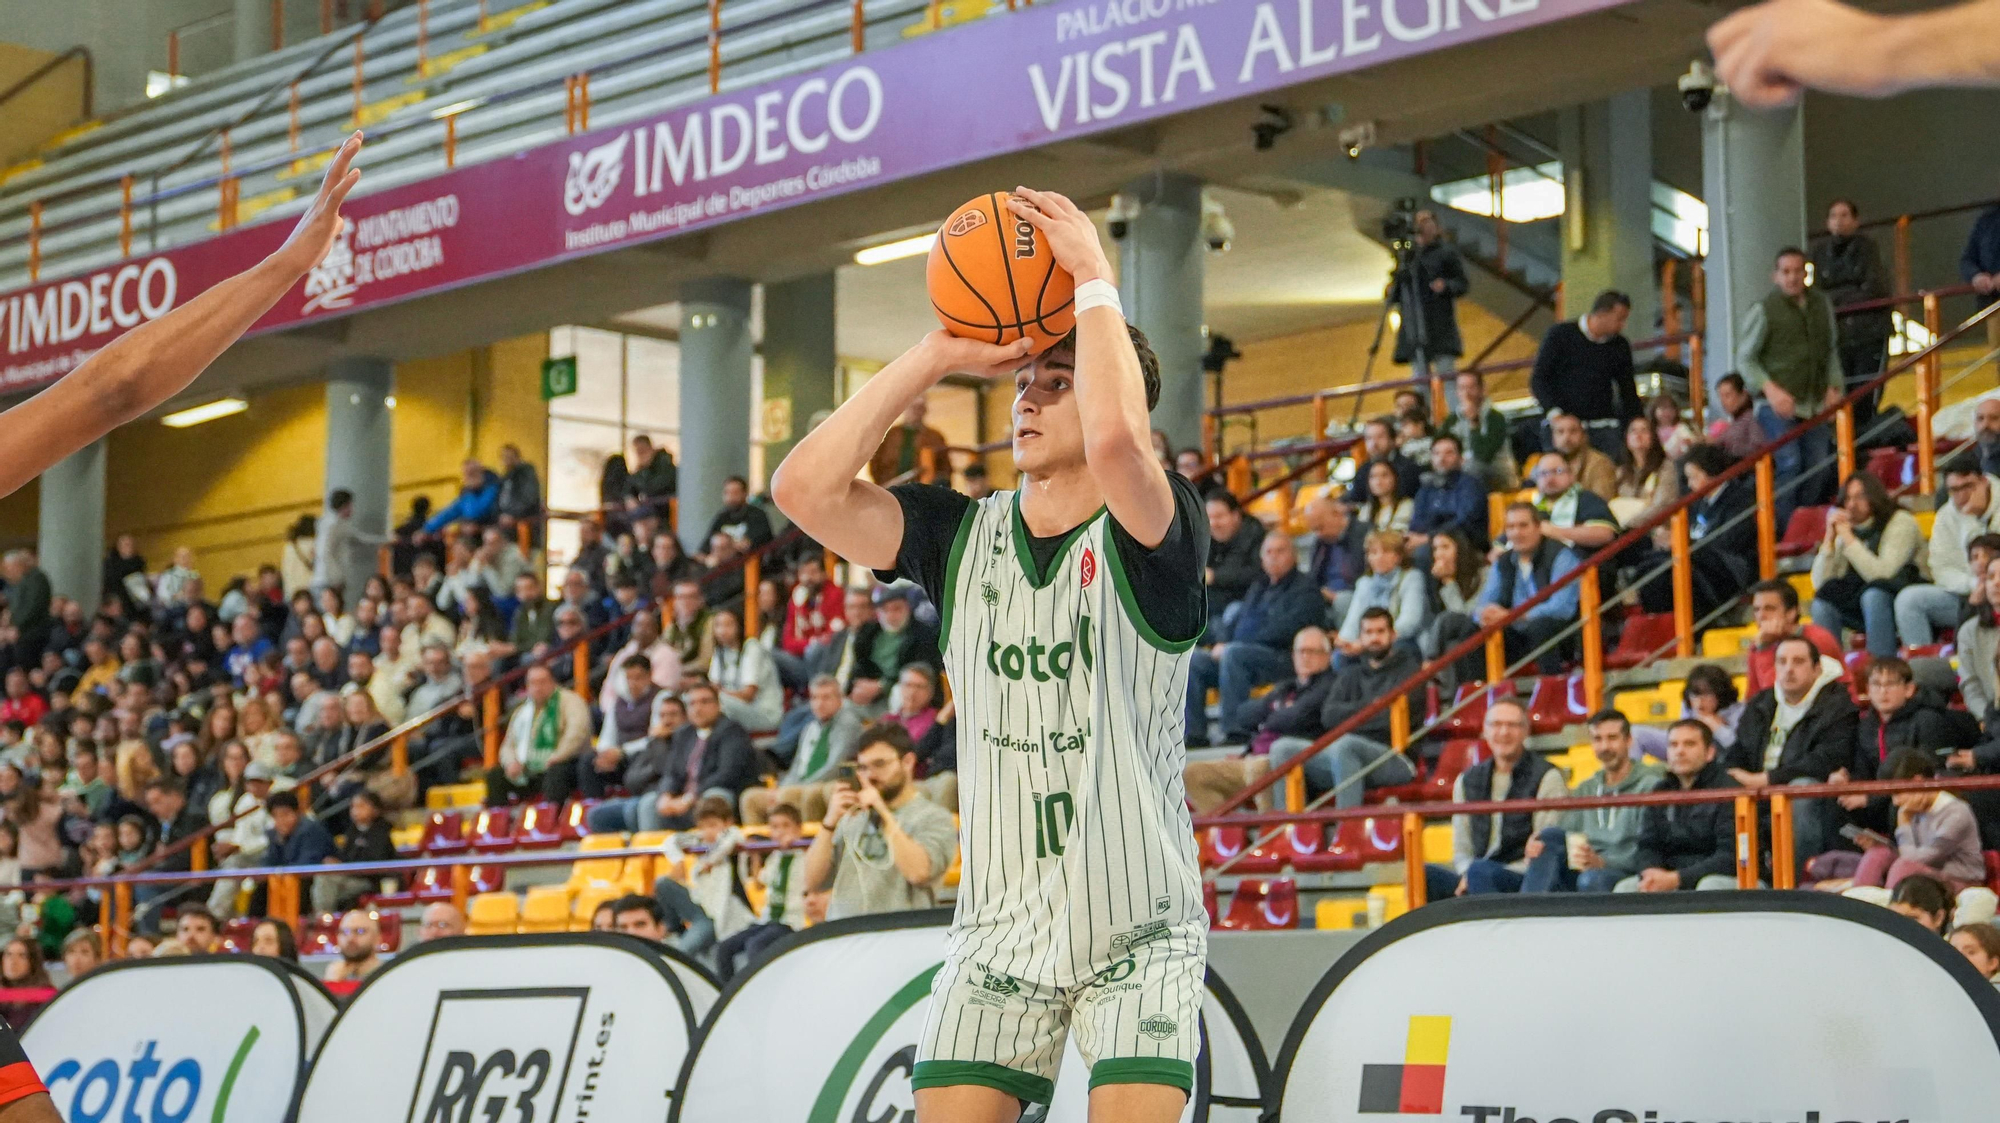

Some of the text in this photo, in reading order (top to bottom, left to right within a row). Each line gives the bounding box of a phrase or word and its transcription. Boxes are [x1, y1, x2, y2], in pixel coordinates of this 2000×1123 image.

[1056, 0, 1171, 43] PALACIO
[1028, 0, 1540, 131] VISTA ALEG
[633, 66, 884, 197] IMDECO
[355, 194, 460, 250] AYUNTAMIENTO
[565, 219, 628, 249] Instituto
[628, 195, 704, 233] Municipal
[704, 191, 728, 216] de
[729, 175, 806, 211] Deportes
[9, 256, 178, 355] IMDECO
[355, 252, 375, 285] DE
[1032, 791, 1075, 859] 10
[424, 1048, 551, 1123] RG3
